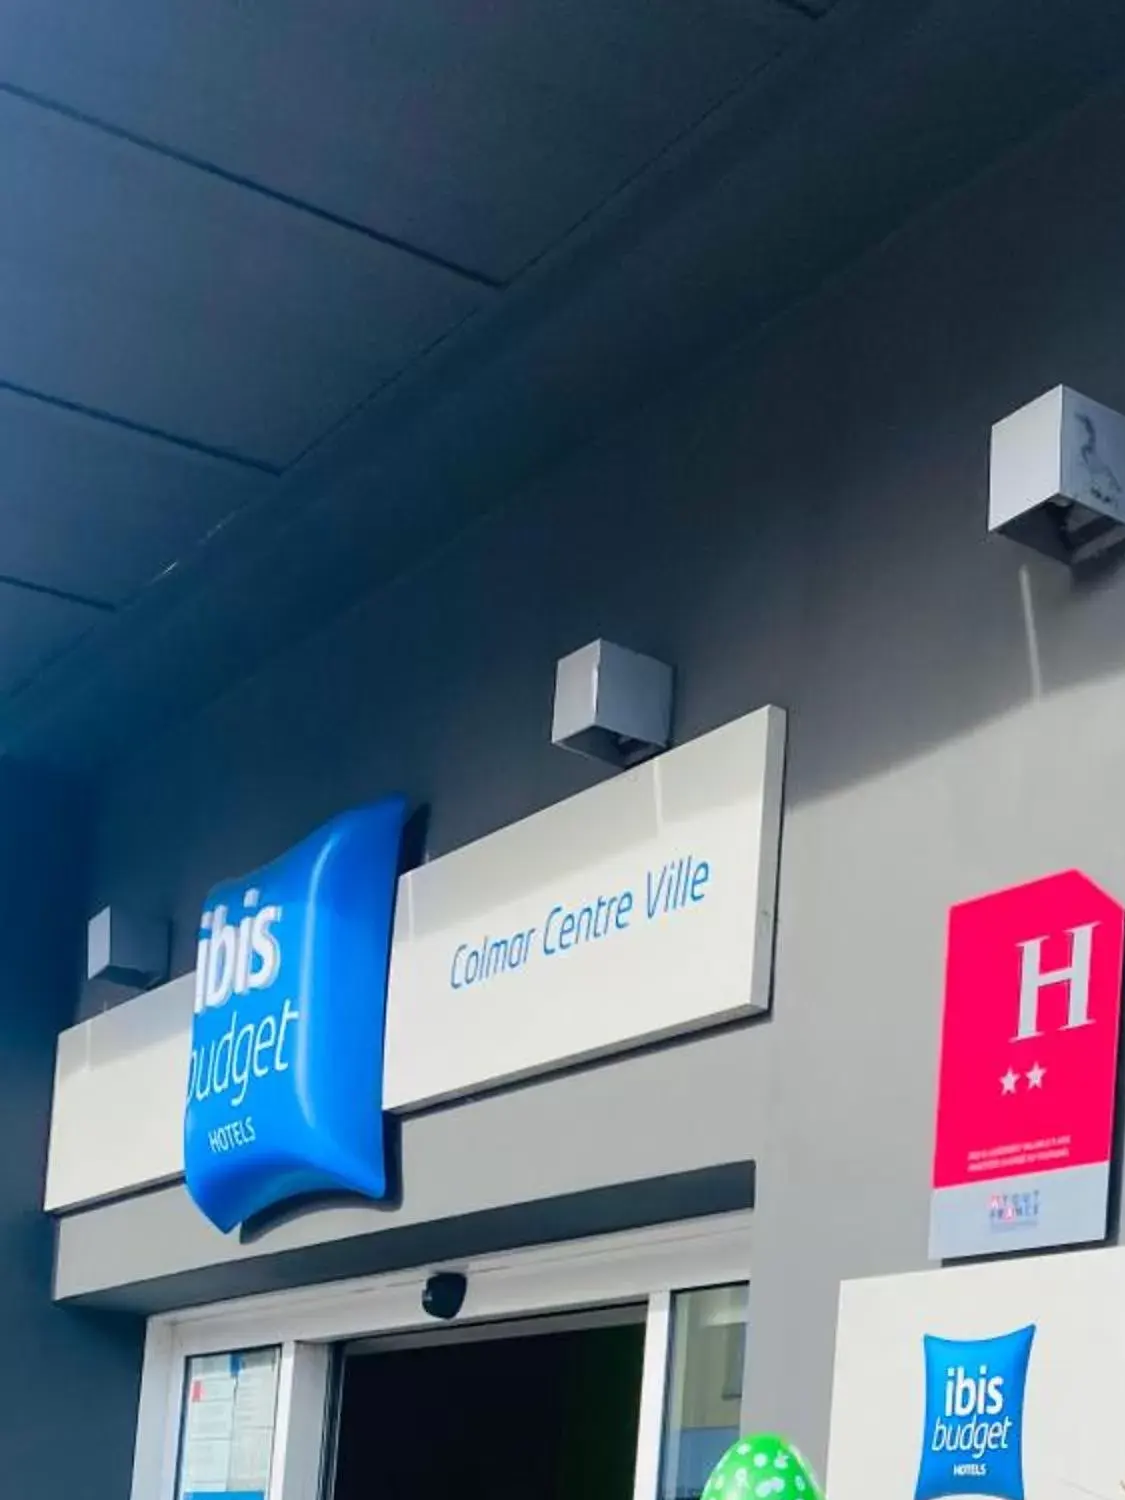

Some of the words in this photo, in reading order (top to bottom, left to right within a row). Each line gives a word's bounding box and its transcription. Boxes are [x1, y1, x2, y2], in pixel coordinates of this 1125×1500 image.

[450, 926, 537, 991] Colmar
[542, 889, 633, 957] Centre
[644, 855, 711, 921] Ville
[194, 887, 281, 1014] ibis
[1007, 920, 1102, 1043] H
[208, 1116, 256, 1153] HOTELS
[944, 1365, 1004, 1416] ibis
[931, 1415, 1013, 1458] budget
[953, 1464, 986, 1476] HOTELS
